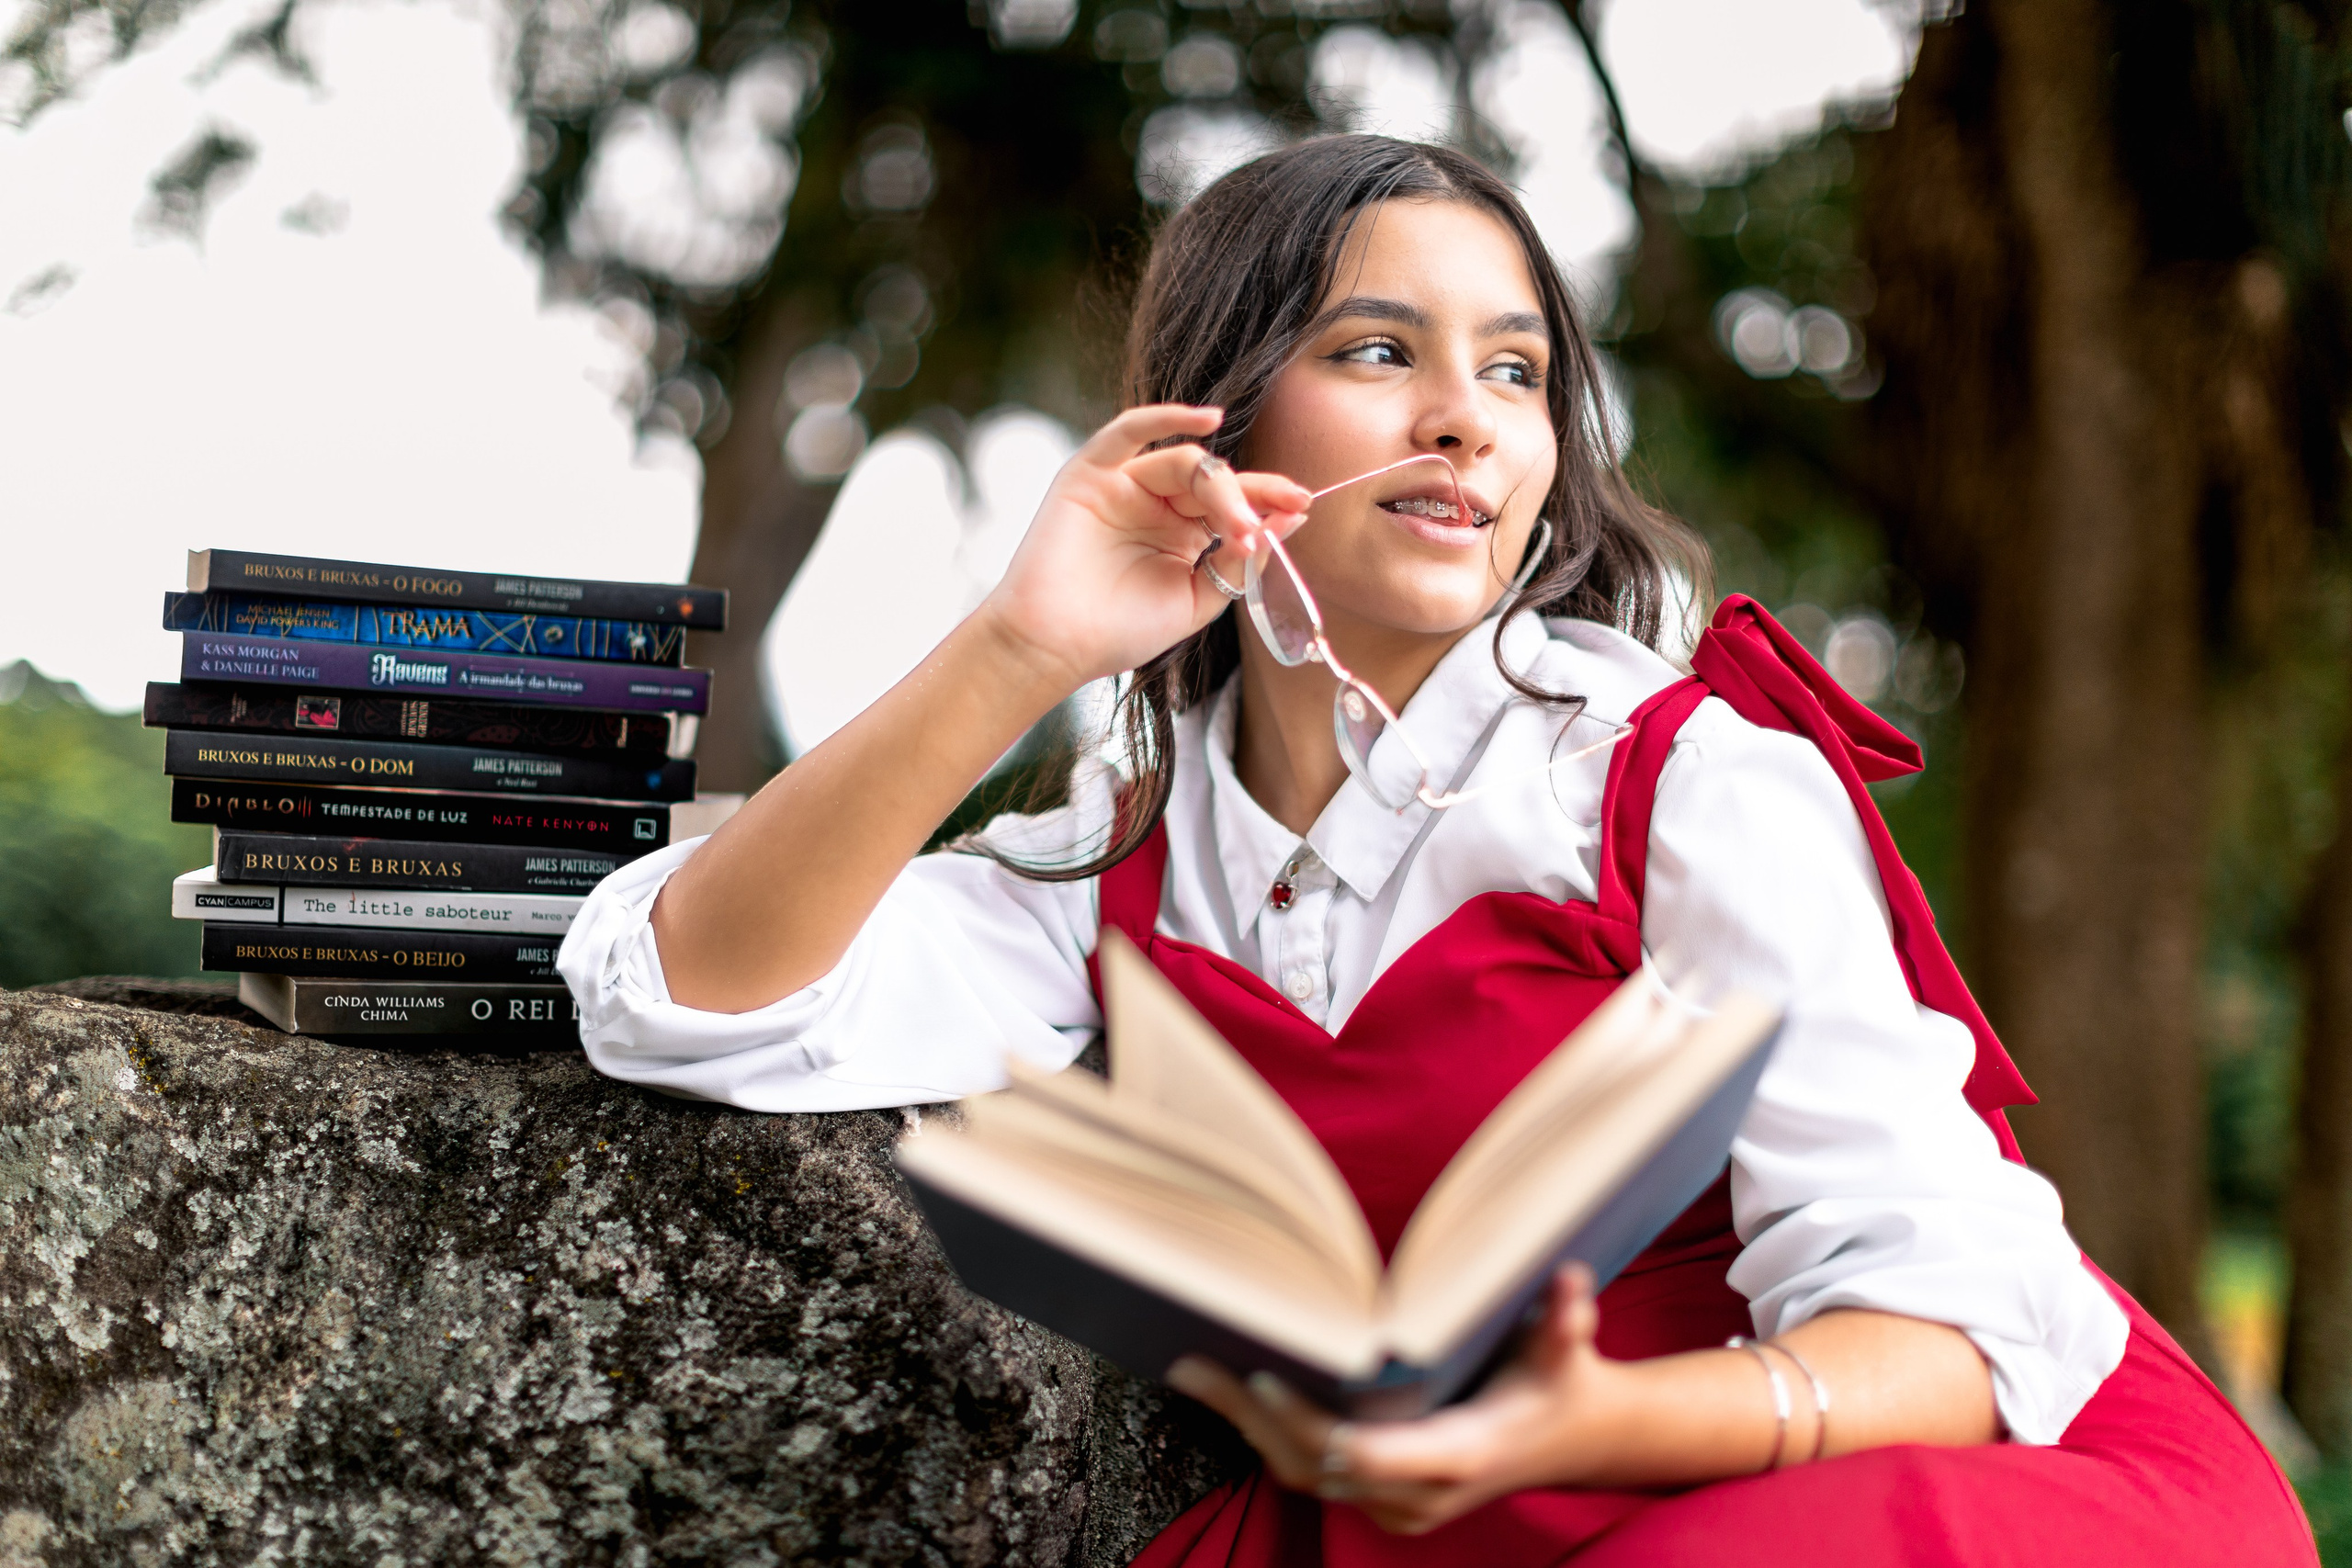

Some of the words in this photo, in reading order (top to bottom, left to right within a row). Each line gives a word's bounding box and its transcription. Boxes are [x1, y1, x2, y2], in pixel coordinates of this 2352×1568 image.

[244, 563, 304, 581] BRUXOS
[309, 569, 317, 581] E
[322, 570, 379, 587] BRUXAS
[393, 575, 407, 592] O
[413, 577, 462, 597] FOGO
[236, 614, 268, 626] DAVID
[313, 620, 339, 630] KING
[382, 611, 470, 641] TRAMA
[203, 643, 235, 656] KASS
[238, 646, 299, 660] MORGAN
[201, 660, 210, 671] &
[214, 660, 278, 677] DANIELLE
[282, 664, 320, 679] PAIGE
[372, 654, 447, 686] Ravens
[459, 671, 469, 683] A
[198, 749, 259, 765] BRUXOS
[264, 752, 273, 765] E
[277, 753, 336, 770] BRUXAS
[351, 757, 366, 773] O
[370, 759, 413, 776] DOM
[473, 758, 505, 773] JAMES
[508, 759, 562, 777] PATTERSON
[195, 793, 294, 818] DIABLO
[321, 803, 412, 820] TEMPESTADE
[417, 809, 435, 822] DE
[441, 811, 468, 824] LUZ
[492, 814, 533, 828] NATE
[543, 818, 609, 832] KENYON
[245, 853, 338, 872] BRUXOS
[348, 858, 361, 873] E
[371, 859, 462, 877] BRUXAS
[525, 857, 558, 872] JAMES
[560, 858, 616, 874] PATTERSON
[198, 897, 224, 907] CYAN
[227, 898, 272, 908] CAMPUS
[304, 899, 336, 913] The
[349, 899, 413, 917] little
[425, 905, 513, 921] saboteur
[532, 911, 562, 921] Marco
[236, 945, 299, 960] BRUXOS
[302, 948, 312, 961] E
[316, 948, 378, 963] BRUXAS
[393, 951, 407, 965] O
[413, 952, 466, 967] BEIJO
[516, 948, 549, 963] JAMES
[324, 996, 369, 1008] CINDA
[376, 997, 445, 1009] WILLIAMS
[471, 998, 492, 1021] O
[507, 999, 555, 1020] REI
[360, 1010, 408, 1021] CHIMA
